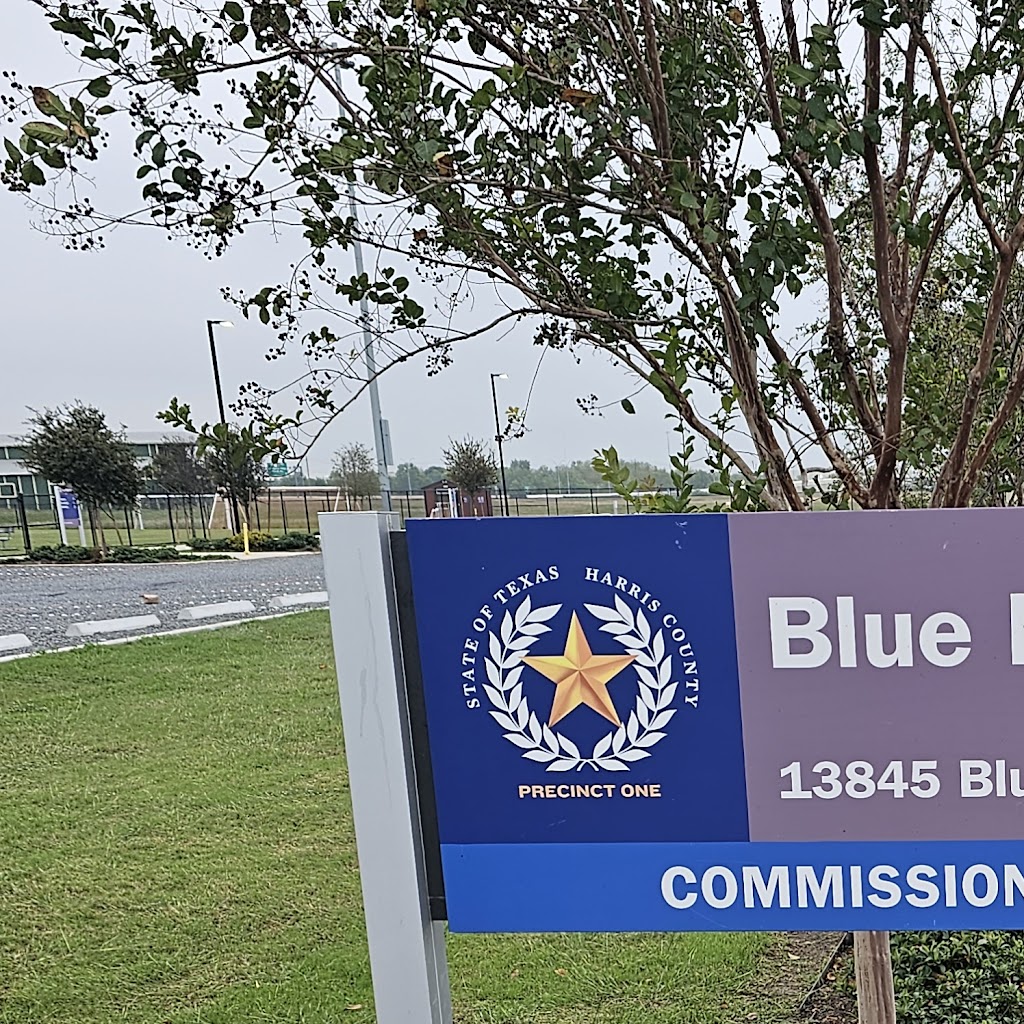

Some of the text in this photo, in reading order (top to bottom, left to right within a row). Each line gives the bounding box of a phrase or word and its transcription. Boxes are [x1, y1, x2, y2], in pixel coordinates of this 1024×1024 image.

[461, 565, 560, 709] STATE OF TEXAS
[584, 566, 700, 708] HARRIS COUNTY
[769, 596, 972, 669] Blue
[518, 783, 662, 799] PRECINCT ONE
[780, 760, 941, 800] 13845
